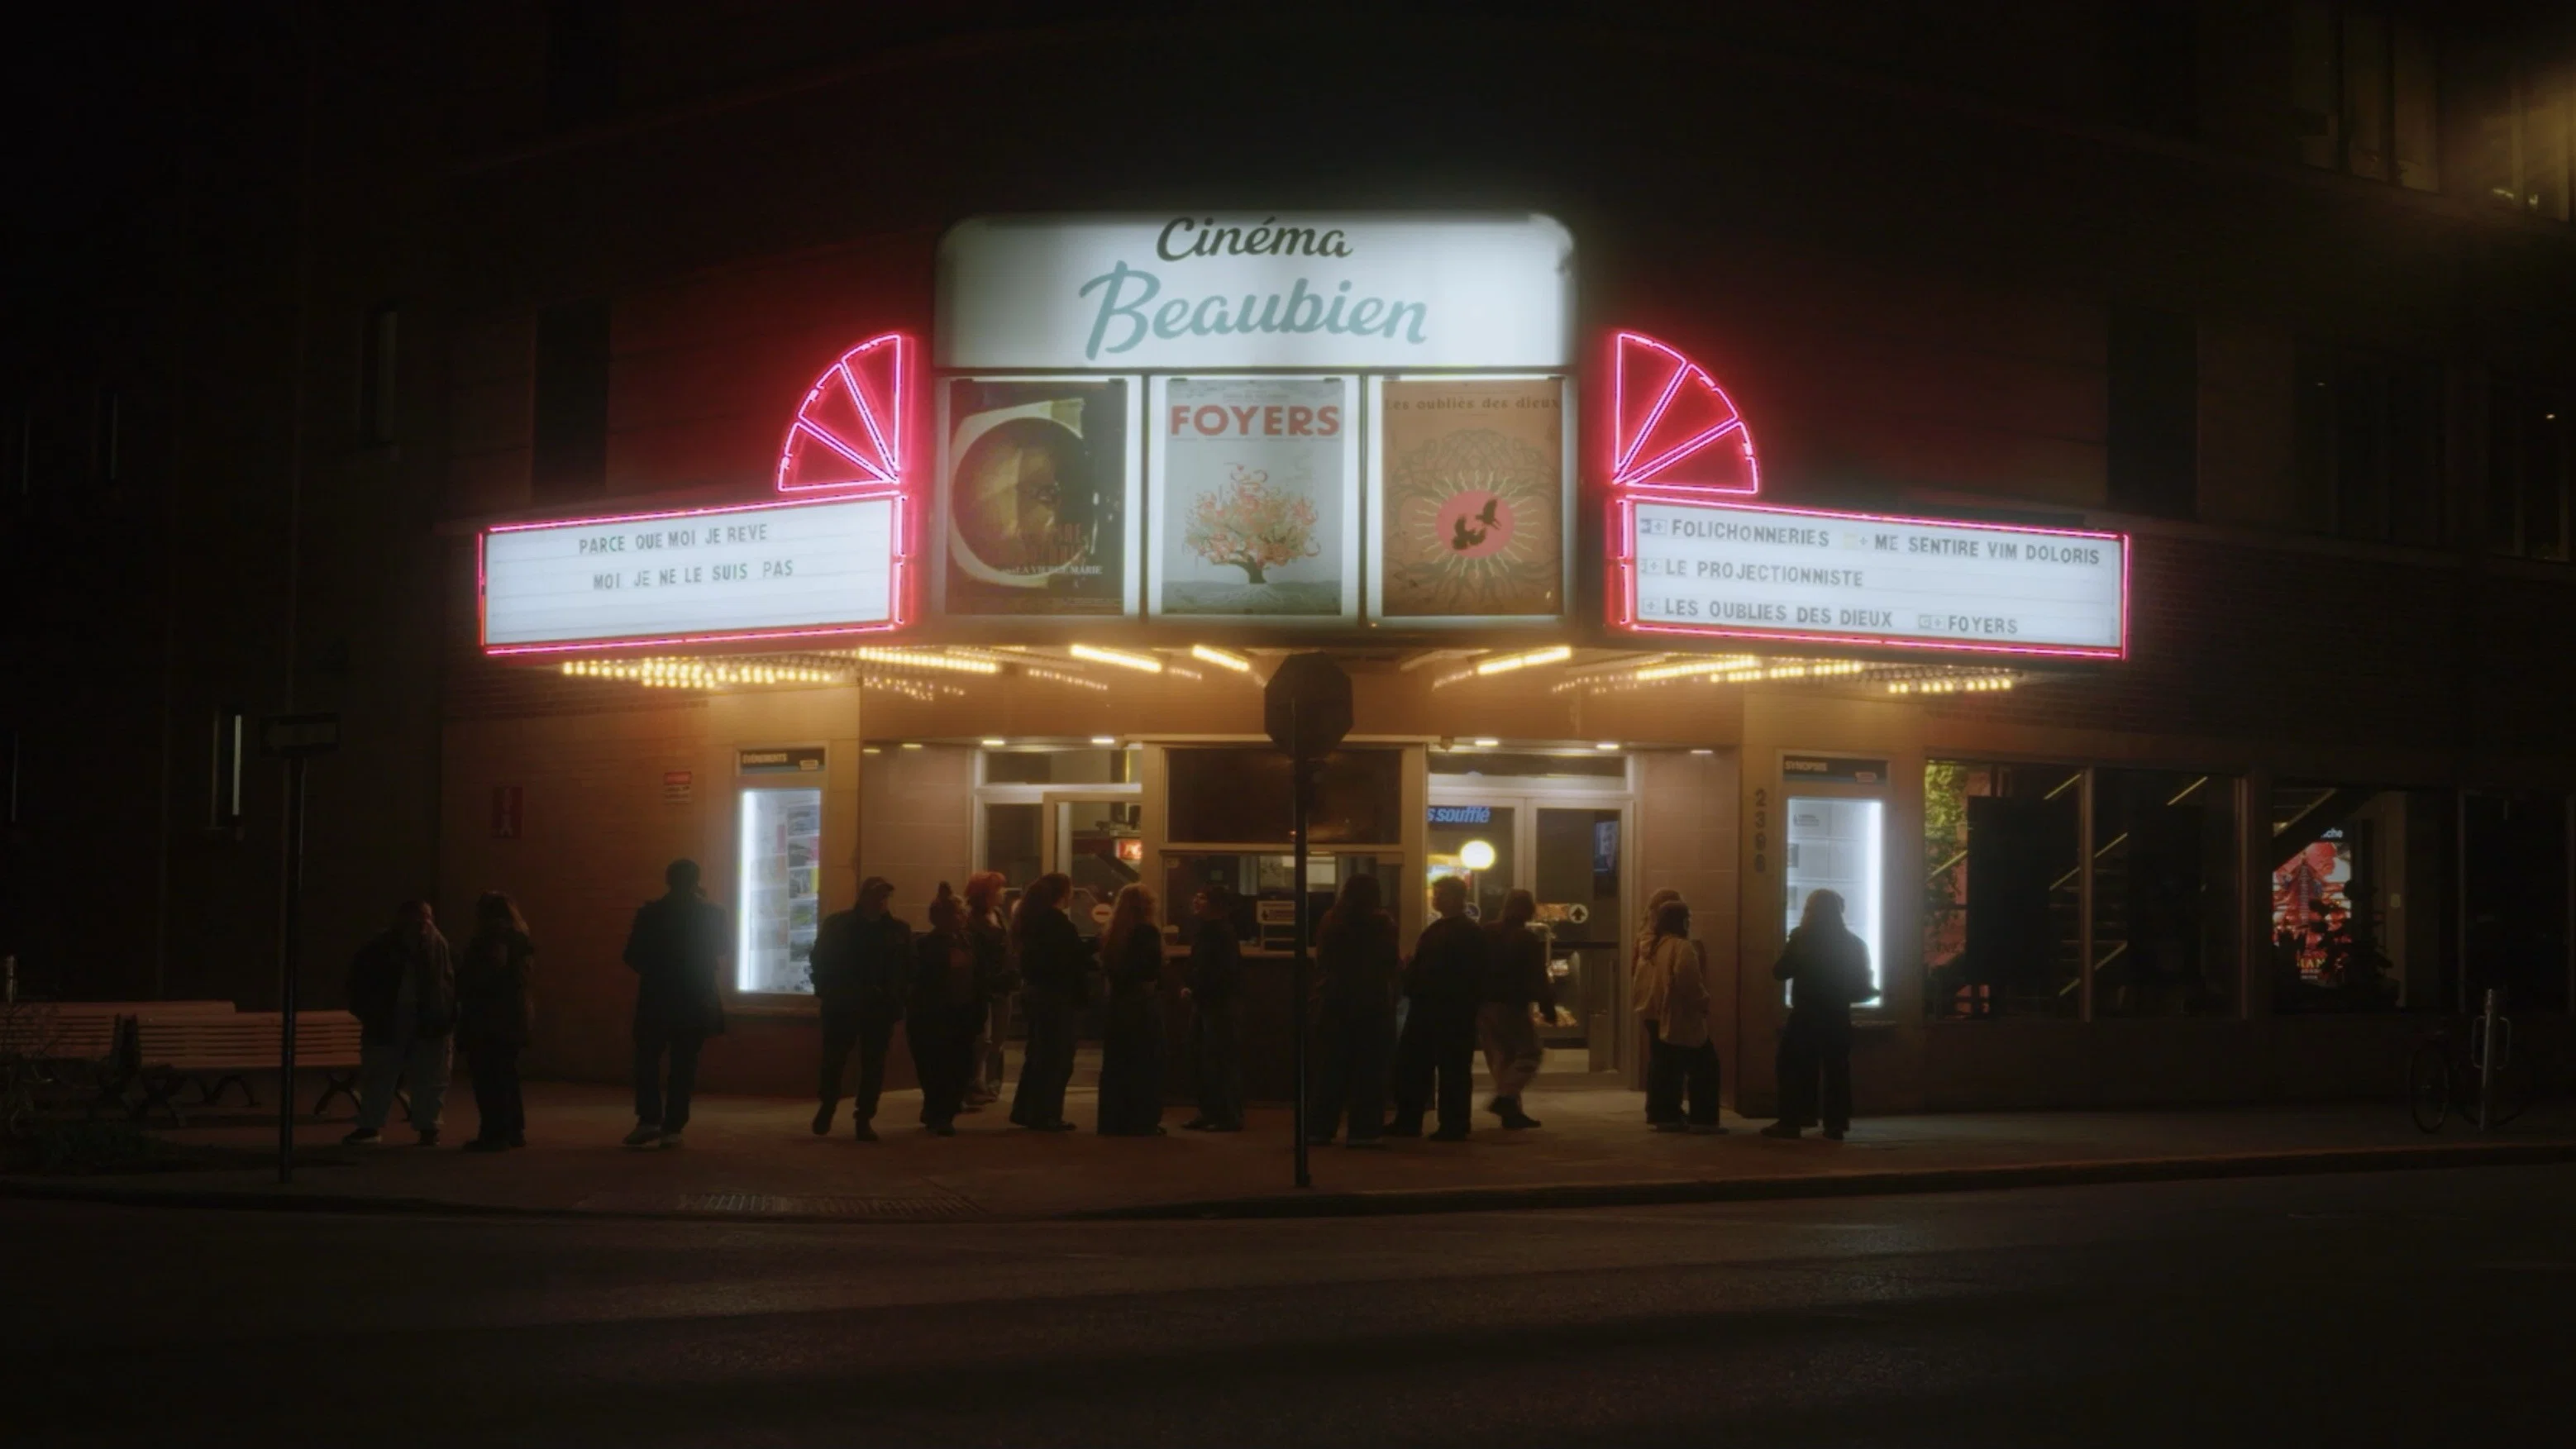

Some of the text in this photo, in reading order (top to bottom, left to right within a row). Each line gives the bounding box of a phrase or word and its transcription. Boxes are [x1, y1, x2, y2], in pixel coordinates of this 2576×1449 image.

[1157, 216, 1353, 262] Cinéma
[1079, 260, 1427, 360] Beaubien
[1481, 397, 1508, 410] des
[1171, 404, 1340, 436] FOYERS
[580, 523, 767, 555] PARCE QUE MOI JE REVE
[1672, 518, 1830, 547] FOLICHONNERIES
[1875, 534, 1899, 551] ME
[1908, 536, 1979, 558] SENTIRE
[1987, 541, 2017, 560] VIM
[2025, 544, 2100, 565] DOLORIS
[594, 559, 793, 589] MOI JE NE LE SUIS PAS
[1666, 560, 1686, 576] LE
[1697, 560, 1863, 587] PROJECTIONNISTE
[1665, 598, 1698, 617] LES
[1709, 600, 1787, 621] OUBLIES
[1796, 607, 1832, 625] DES
[1839, 608, 1893, 628] DIEUX
[1949, 614, 2018, 635] FOYERS
